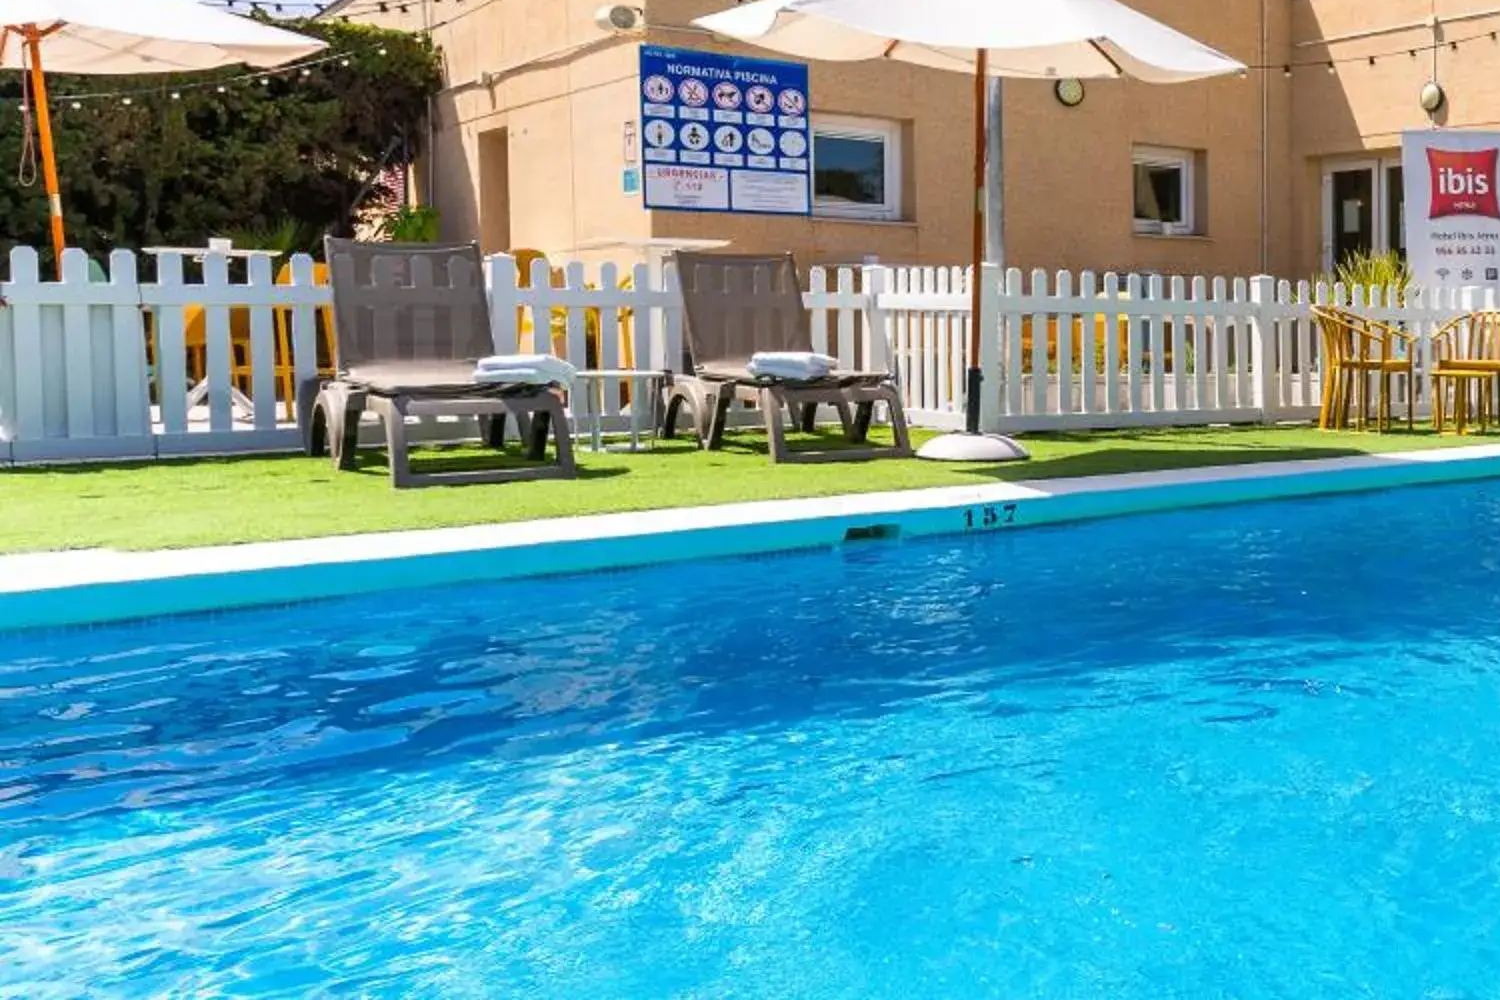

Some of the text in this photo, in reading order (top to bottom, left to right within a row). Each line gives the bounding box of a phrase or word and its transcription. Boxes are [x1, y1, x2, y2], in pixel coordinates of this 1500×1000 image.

[666, 63, 779, 86] NORMATIVA PISCINA
[1438, 167, 1490, 196] ibis
[963, 503, 1017, 528] 157
